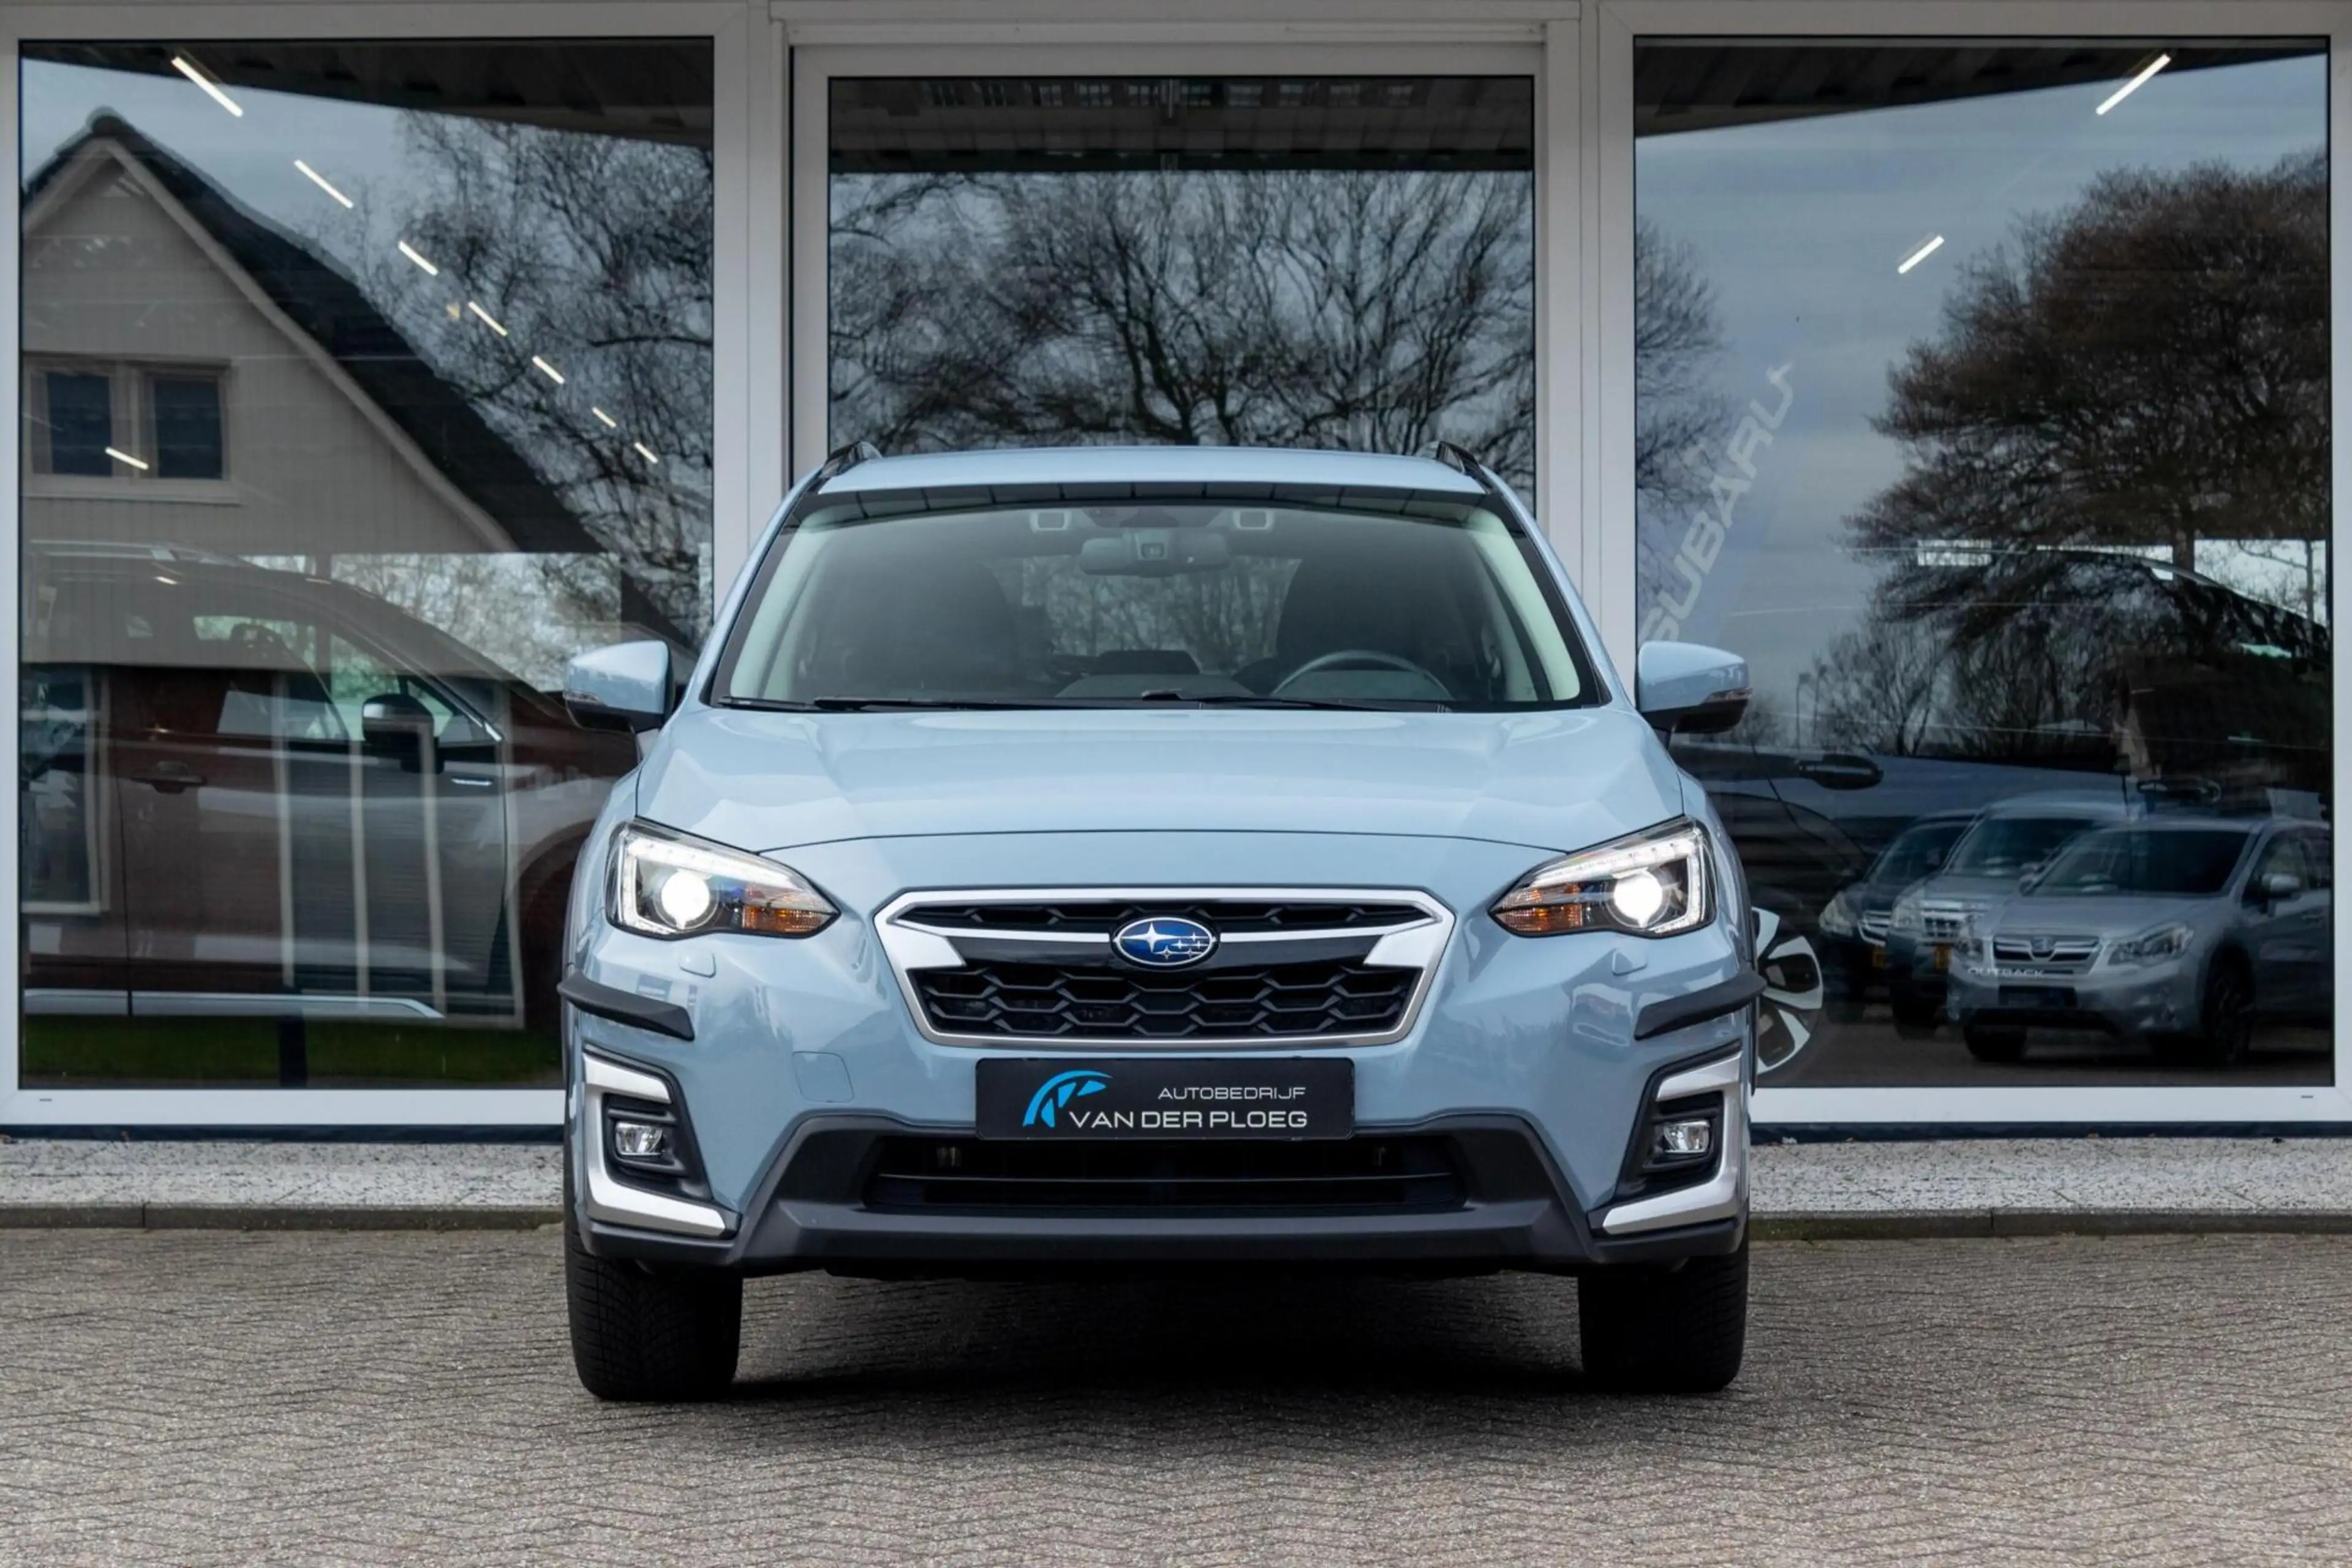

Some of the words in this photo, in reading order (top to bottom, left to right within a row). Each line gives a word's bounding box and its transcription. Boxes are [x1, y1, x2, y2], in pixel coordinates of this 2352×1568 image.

[1158, 1087, 1306, 1100] AUTOBEDRIJF
[1069, 1110, 1134, 1128] VAN
[1141, 1110, 1203, 1128] DER
[1210, 1110, 1308, 1128] PLOEG
